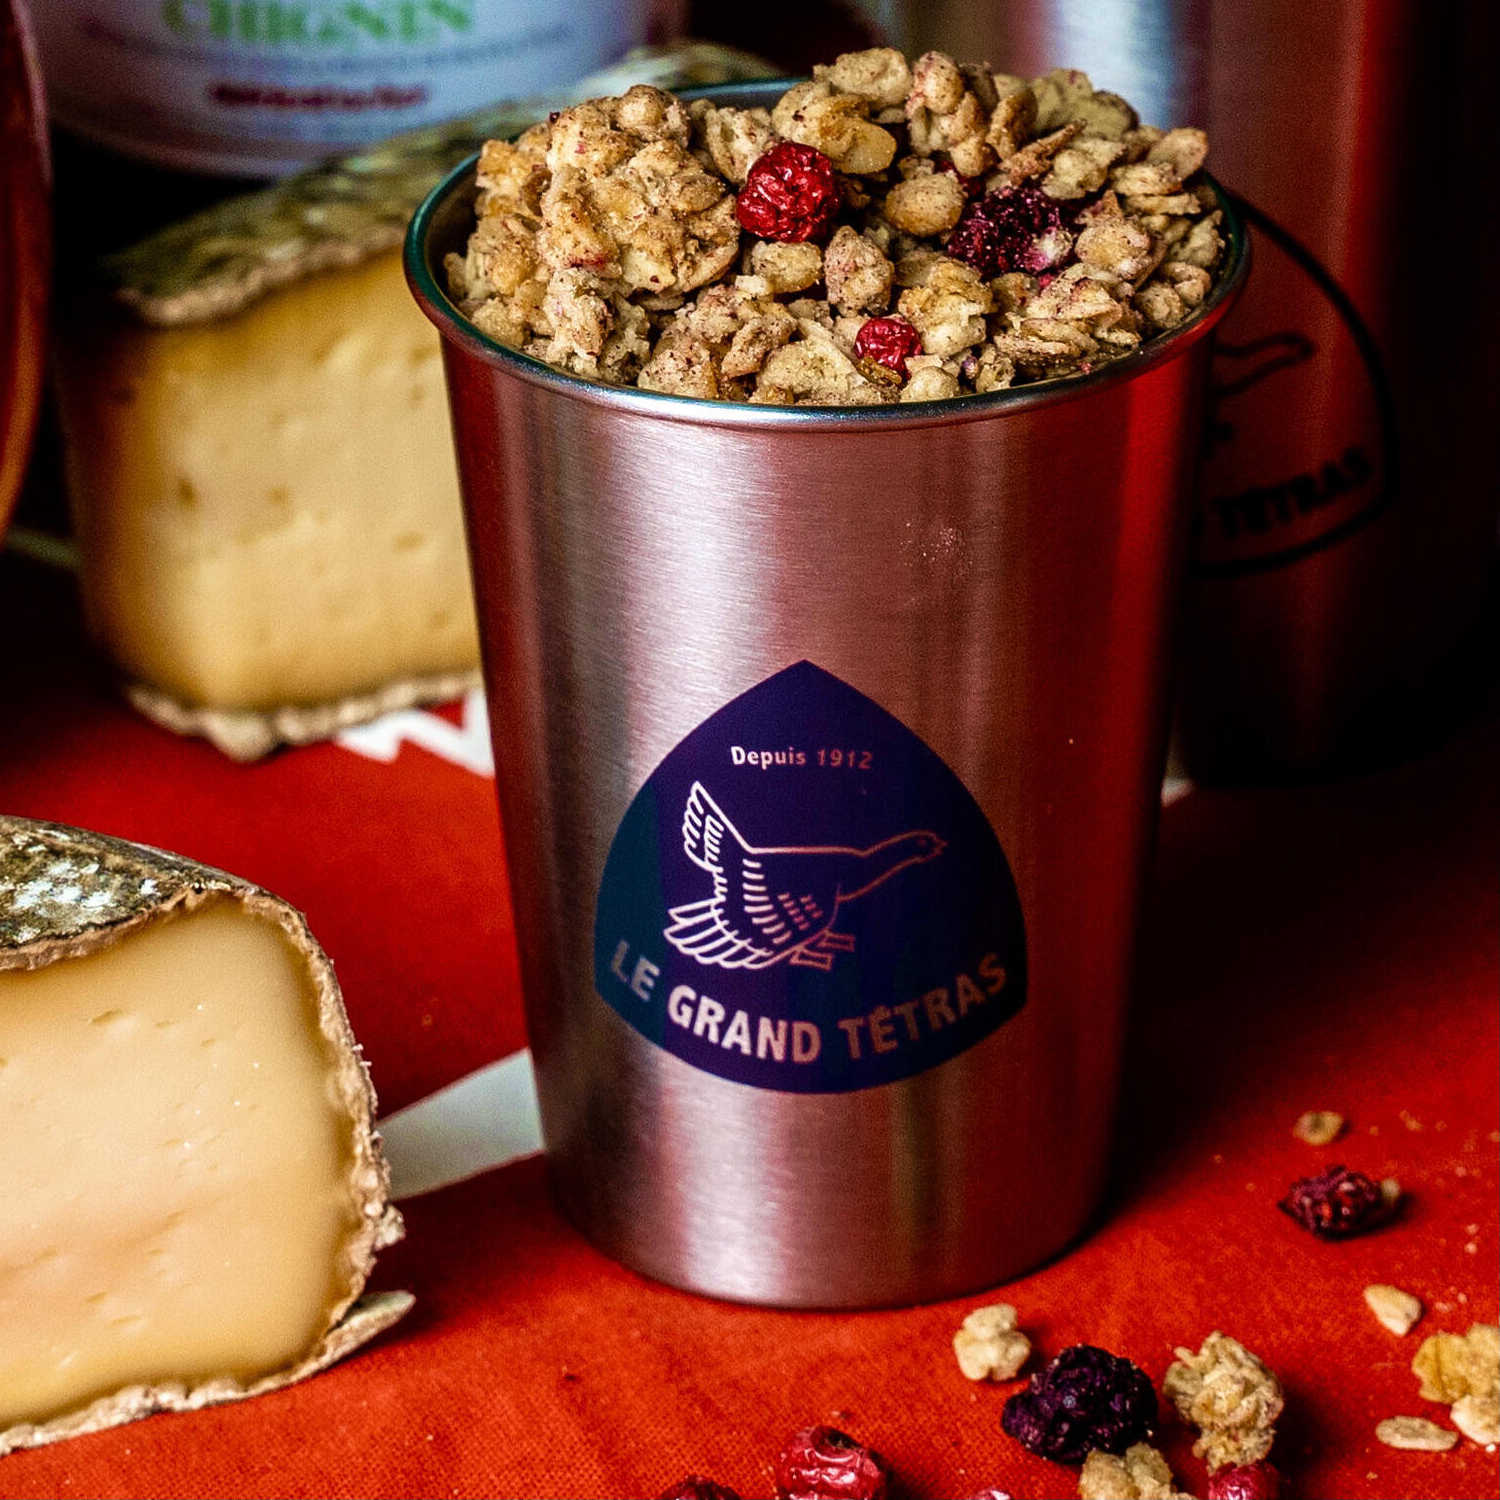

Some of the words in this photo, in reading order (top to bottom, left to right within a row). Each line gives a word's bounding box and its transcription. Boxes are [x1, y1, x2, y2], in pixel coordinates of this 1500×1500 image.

[730, 745, 806, 770] Depuis
[816, 747, 875, 770] 1912
[610, 939, 661, 1002] LE
[667, 984, 822, 1065] GRAND
[837, 952, 1008, 1061] TÉTRAS
